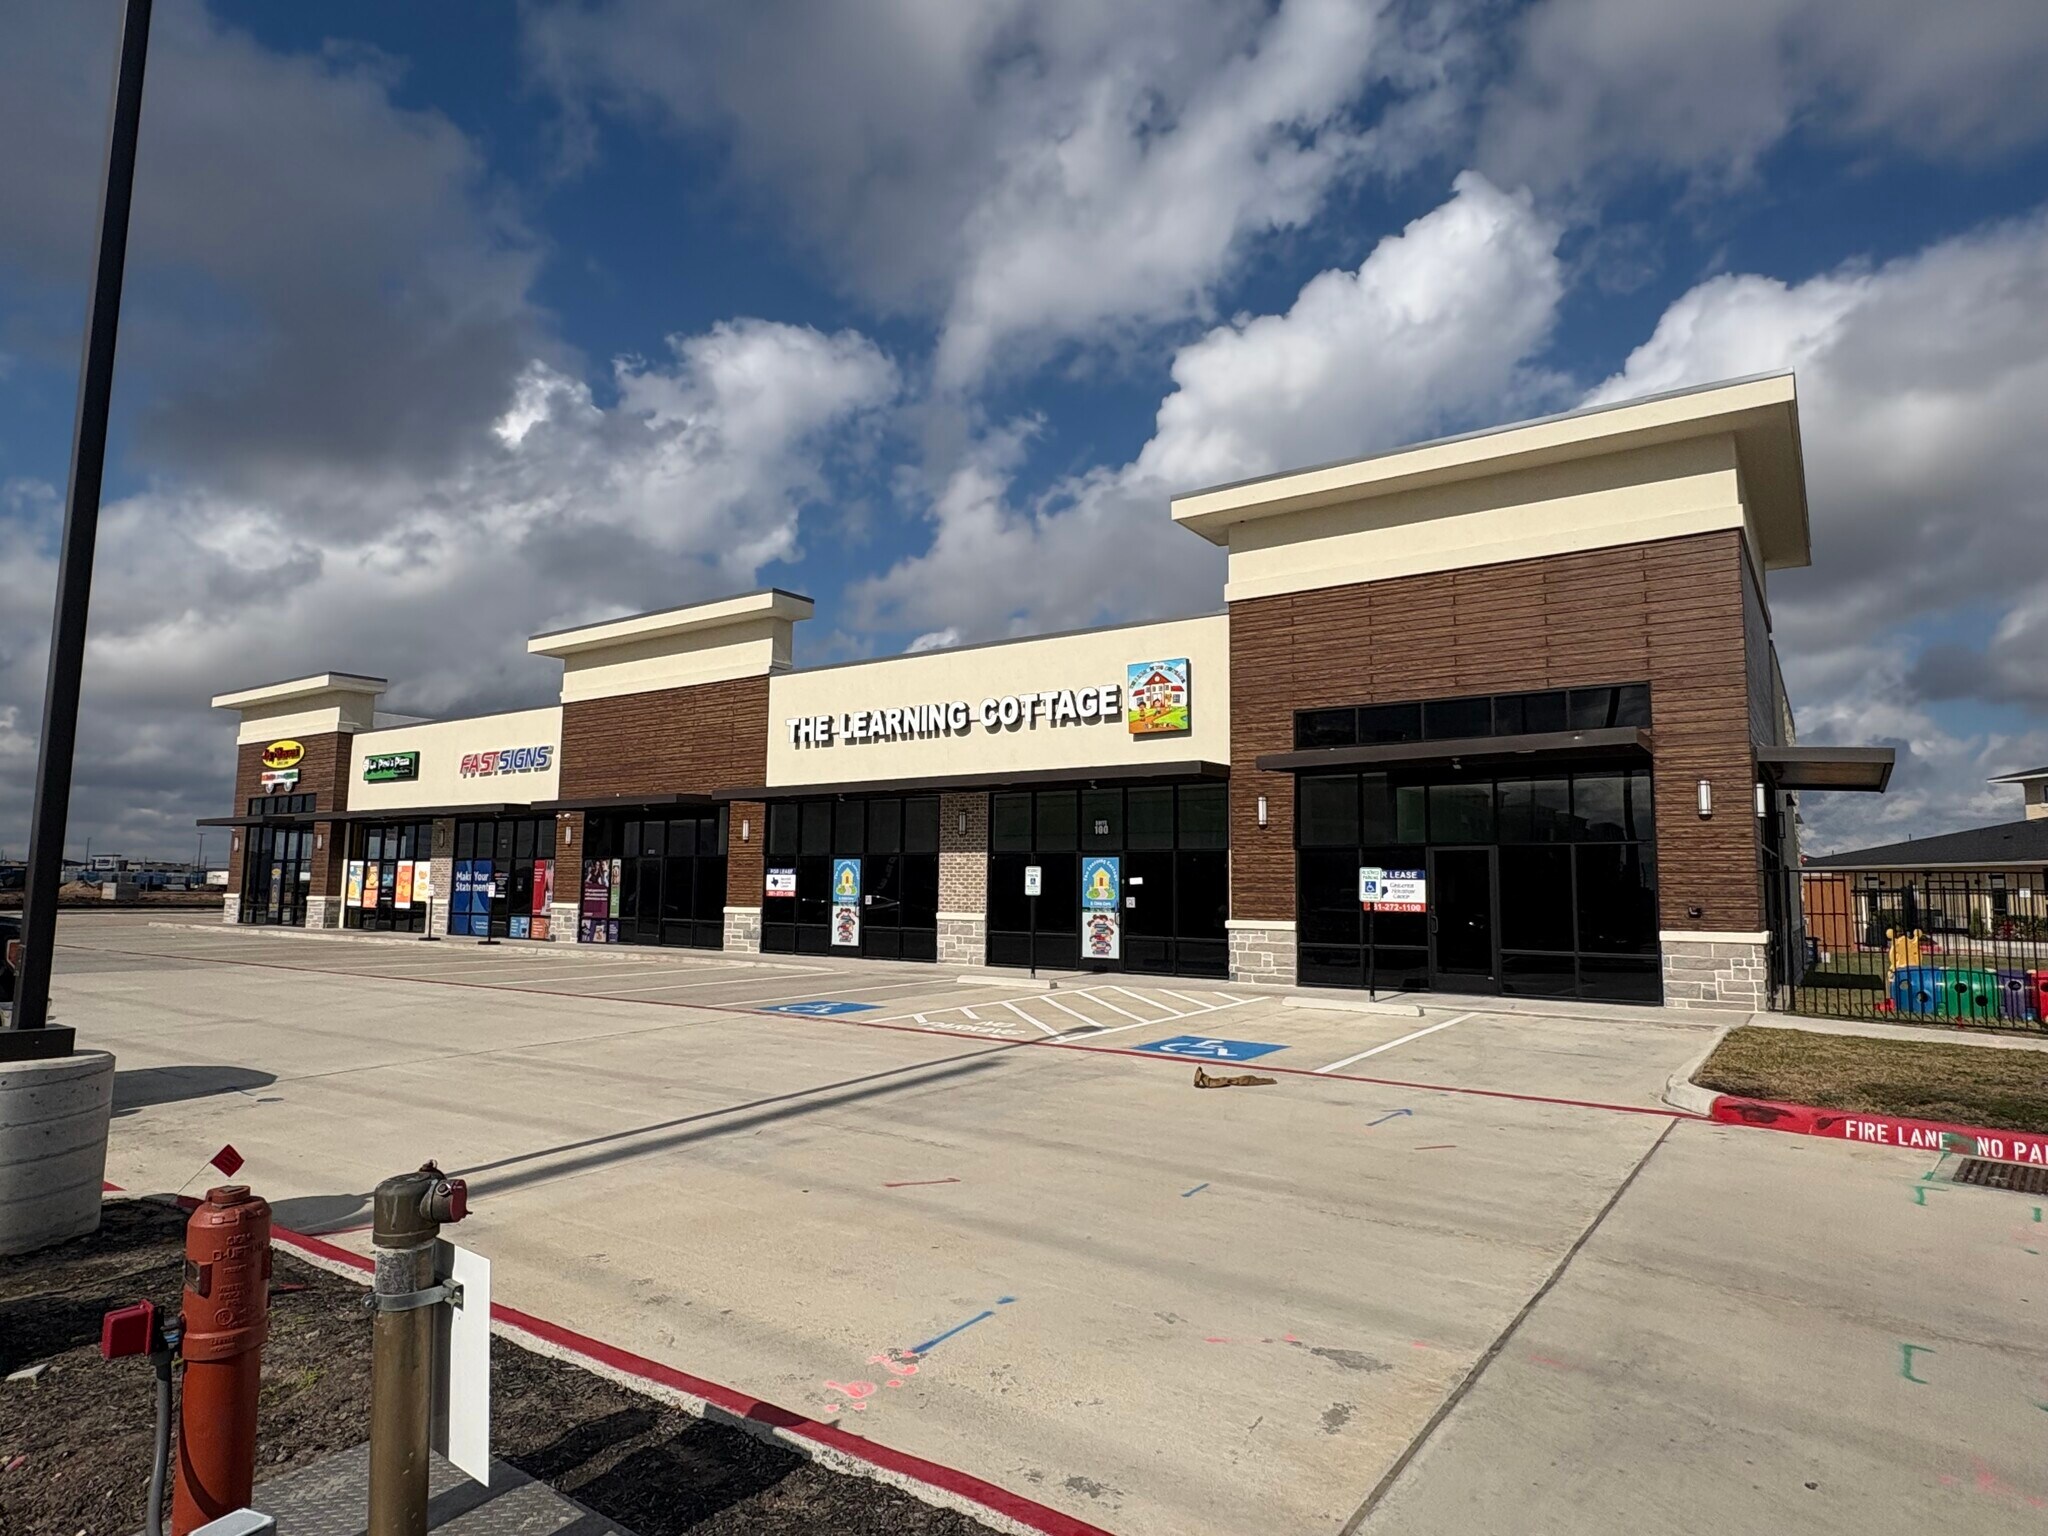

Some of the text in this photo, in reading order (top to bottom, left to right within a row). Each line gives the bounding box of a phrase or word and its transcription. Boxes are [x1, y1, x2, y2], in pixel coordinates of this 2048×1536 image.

[786, 684, 1120, 744] THE LEARNING COTTAGE
[459, 746, 550, 774] FASTSIGNS
[473, 871, 490, 881] Your
[1389, 871, 1418, 879] LEASE
[1367, 903, 1421, 912] 81-272-1100
[1845, 1119, 1889, 1144] FIRE
[1898, 1126, 1951, 1150] LANE
[1976, 1135, 2004, 1159] NO
